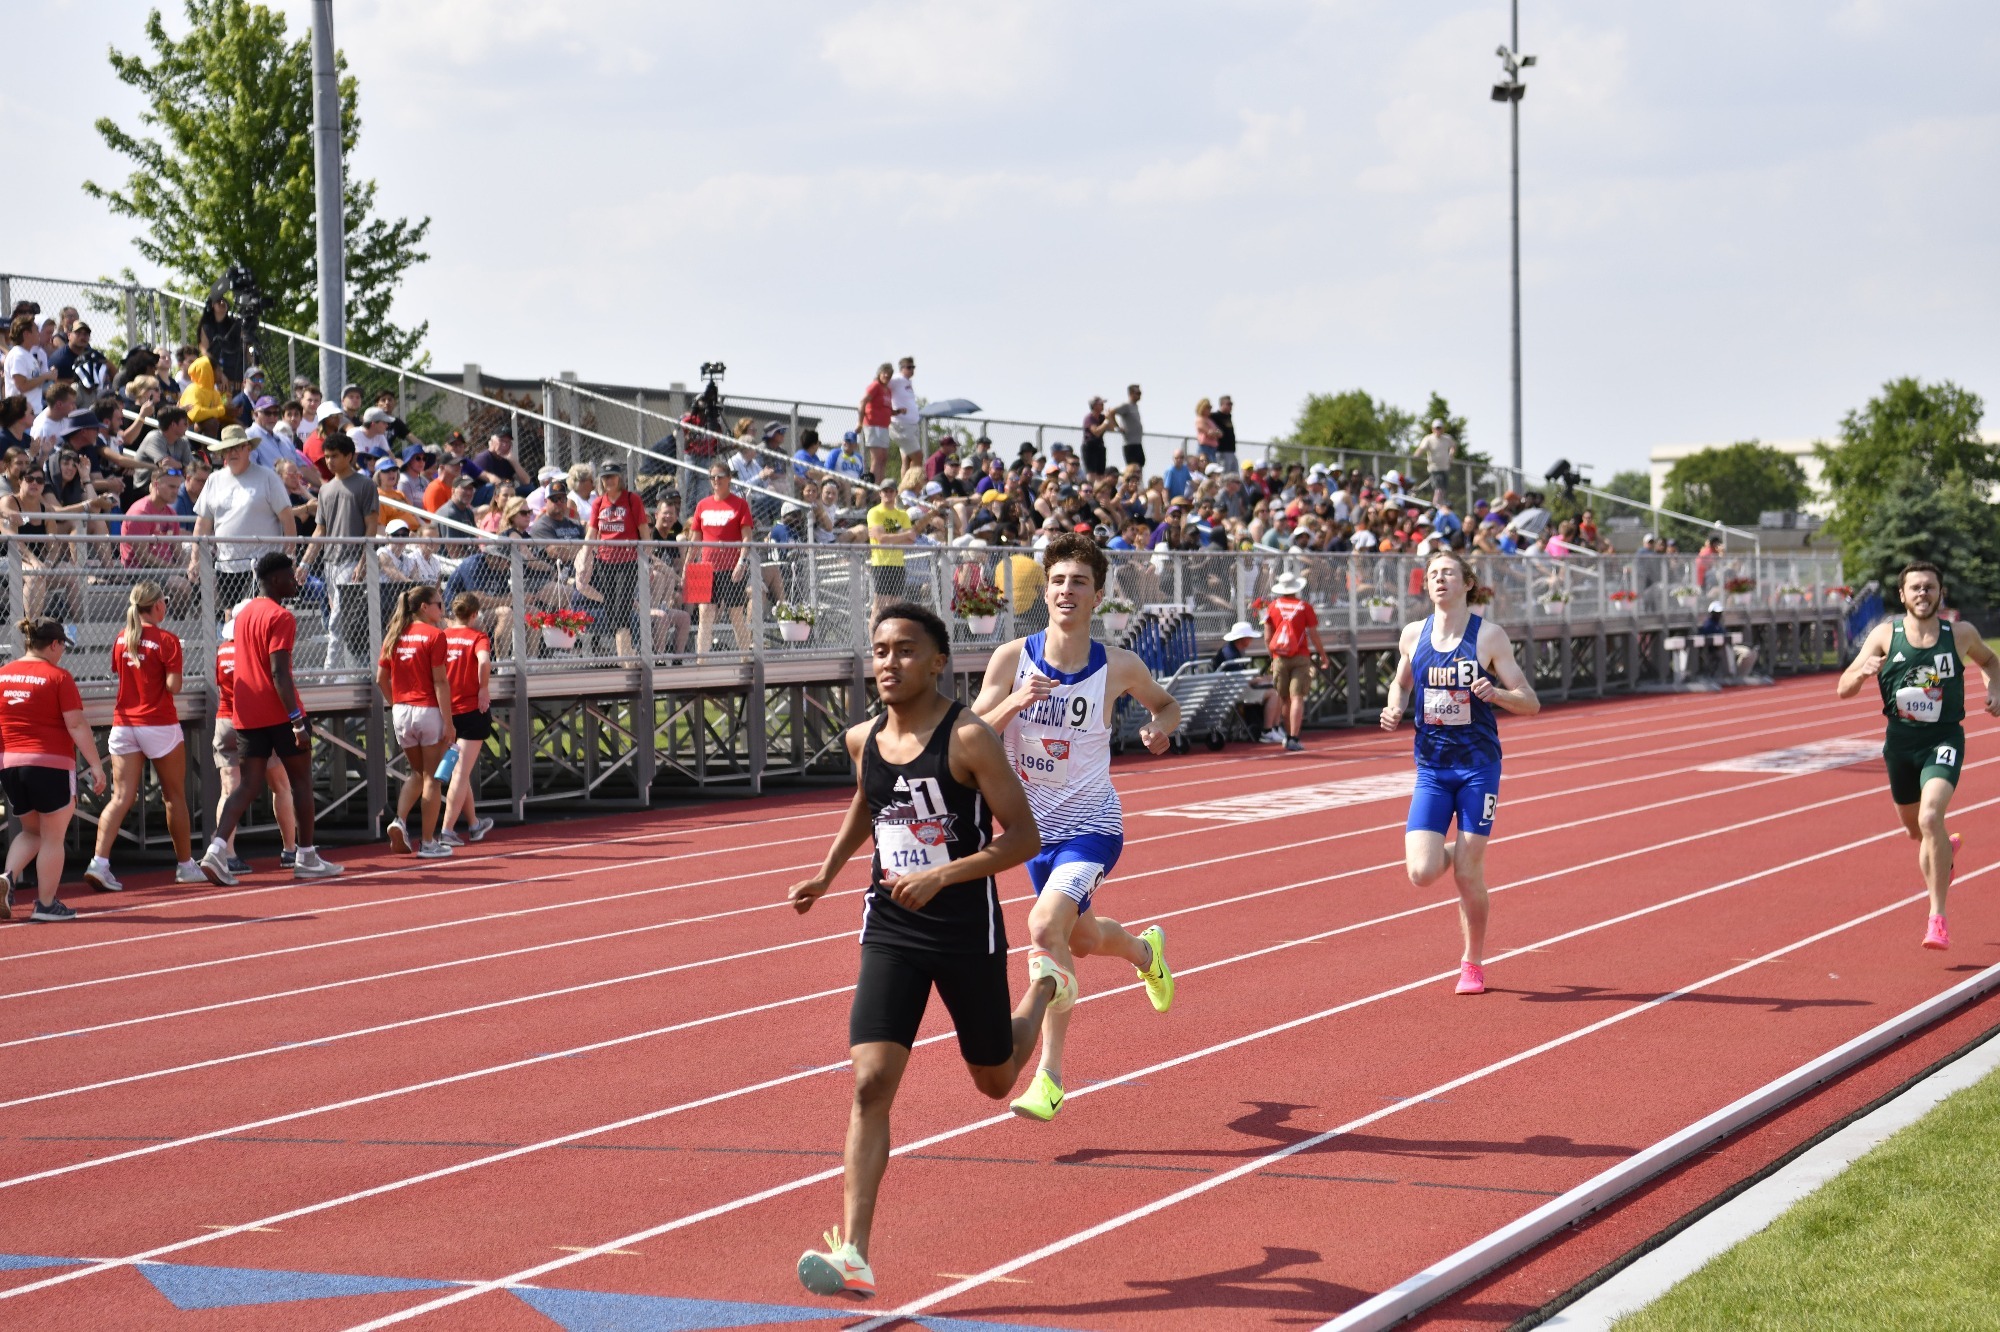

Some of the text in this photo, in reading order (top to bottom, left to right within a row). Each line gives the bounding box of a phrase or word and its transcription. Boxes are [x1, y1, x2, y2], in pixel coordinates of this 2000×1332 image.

[1462, 663, 1474, 686] 3
[1940, 655, 1951, 676] 4
[1428, 667, 1456, 687] UBC
[3, 690, 31, 698] BROOKS
[1071, 696, 1088, 727] 9
[1434, 704, 1460, 715] 1683
[1906, 701, 1934, 712] 1994
[1020, 753, 1055, 773] 1966
[1940, 748, 1952, 763] 4
[915, 780, 937, 816] 1
[1486, 796, 1495, 819] 3
[892, 848, 931, 867] 1741
